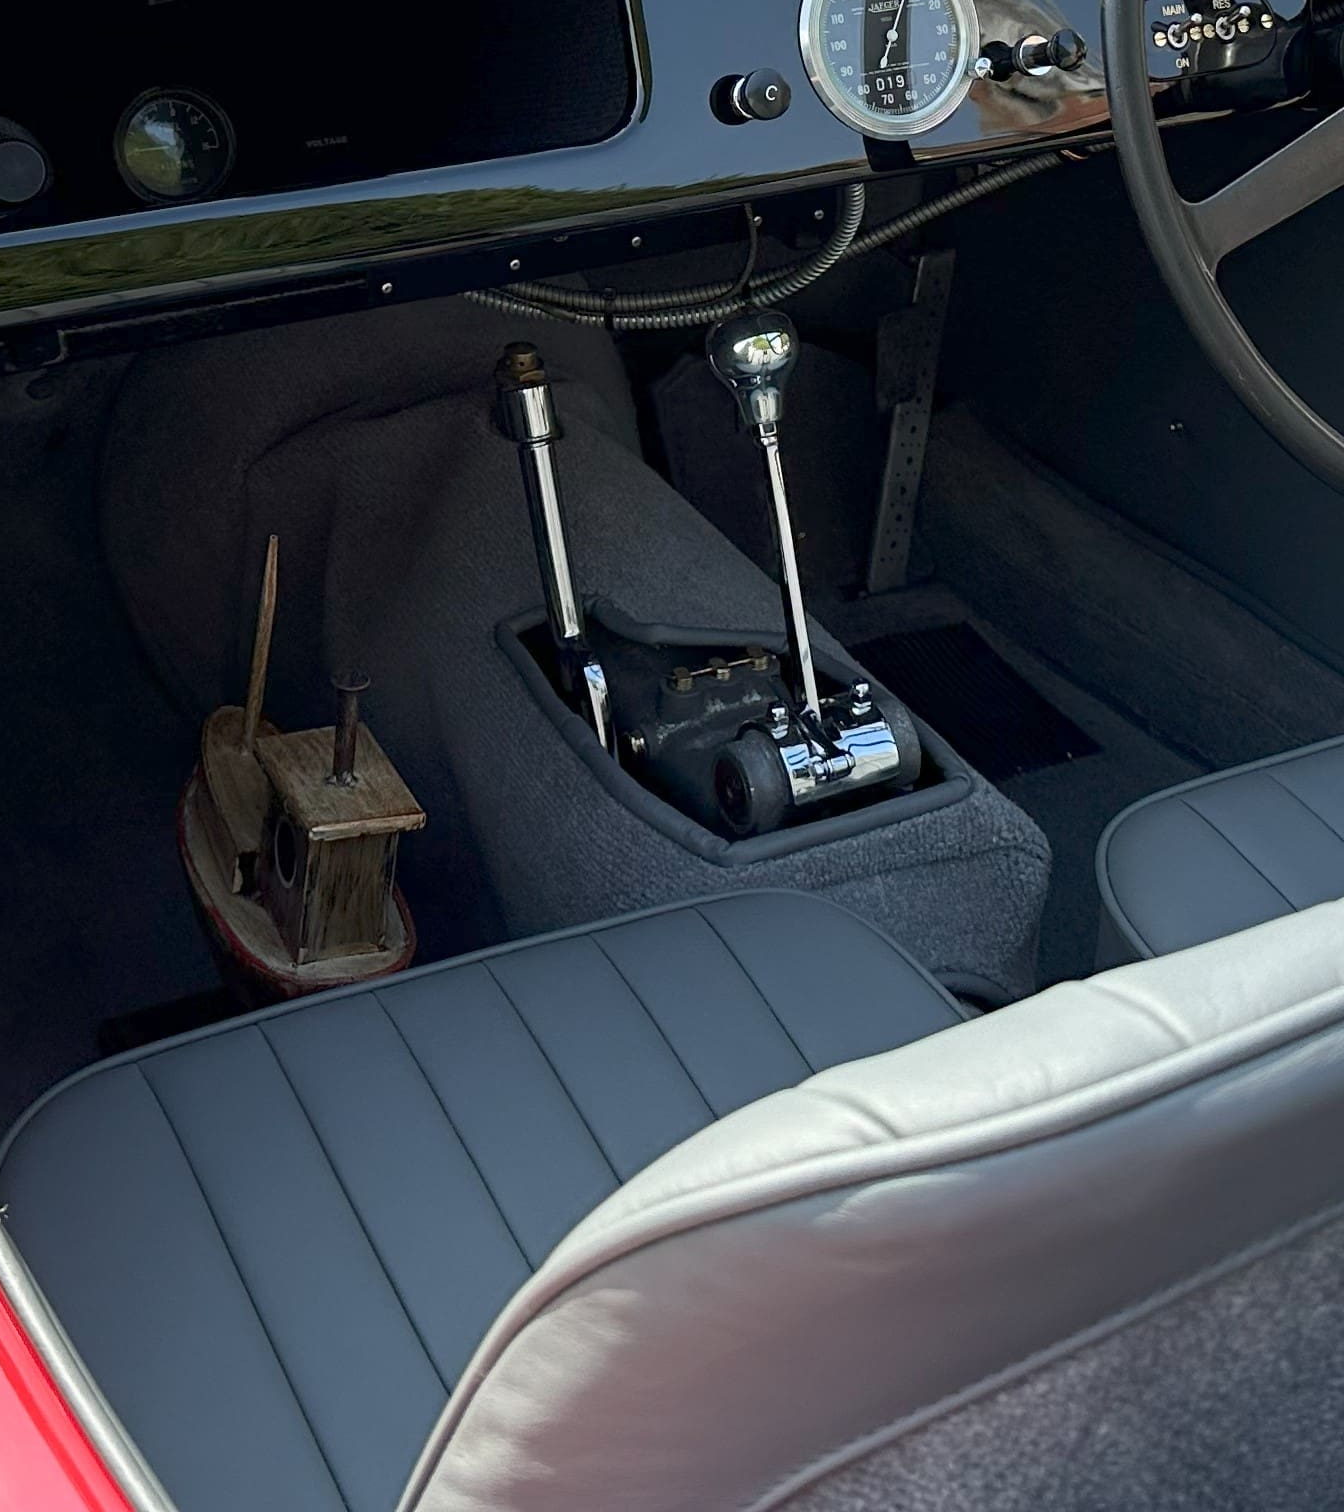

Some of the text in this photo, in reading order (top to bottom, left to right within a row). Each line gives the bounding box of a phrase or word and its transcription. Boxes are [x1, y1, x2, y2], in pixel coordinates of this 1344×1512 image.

[869, 0, 900, 11] JAEGER
[928, 0, 940, 10] 20
[1162, 3, 1185, 16] MAIN
[831, 13, 844, 25] 110
[936, 25, 949, 36] 30
[831, 39, 847, 51] 100
[934, 51, 947, 62] 40
[1176, 58, 1190, 69] ON
[840, 65, 854, 76] 90
[876, 75, 905, 91] 019
[923, 73, 937, 85] 50
[765, 84, 778, 101] C
[857, 84, 870, 96] 80
[905, 90, 918, 101] 60
[881, 93, 894, 105] 70
